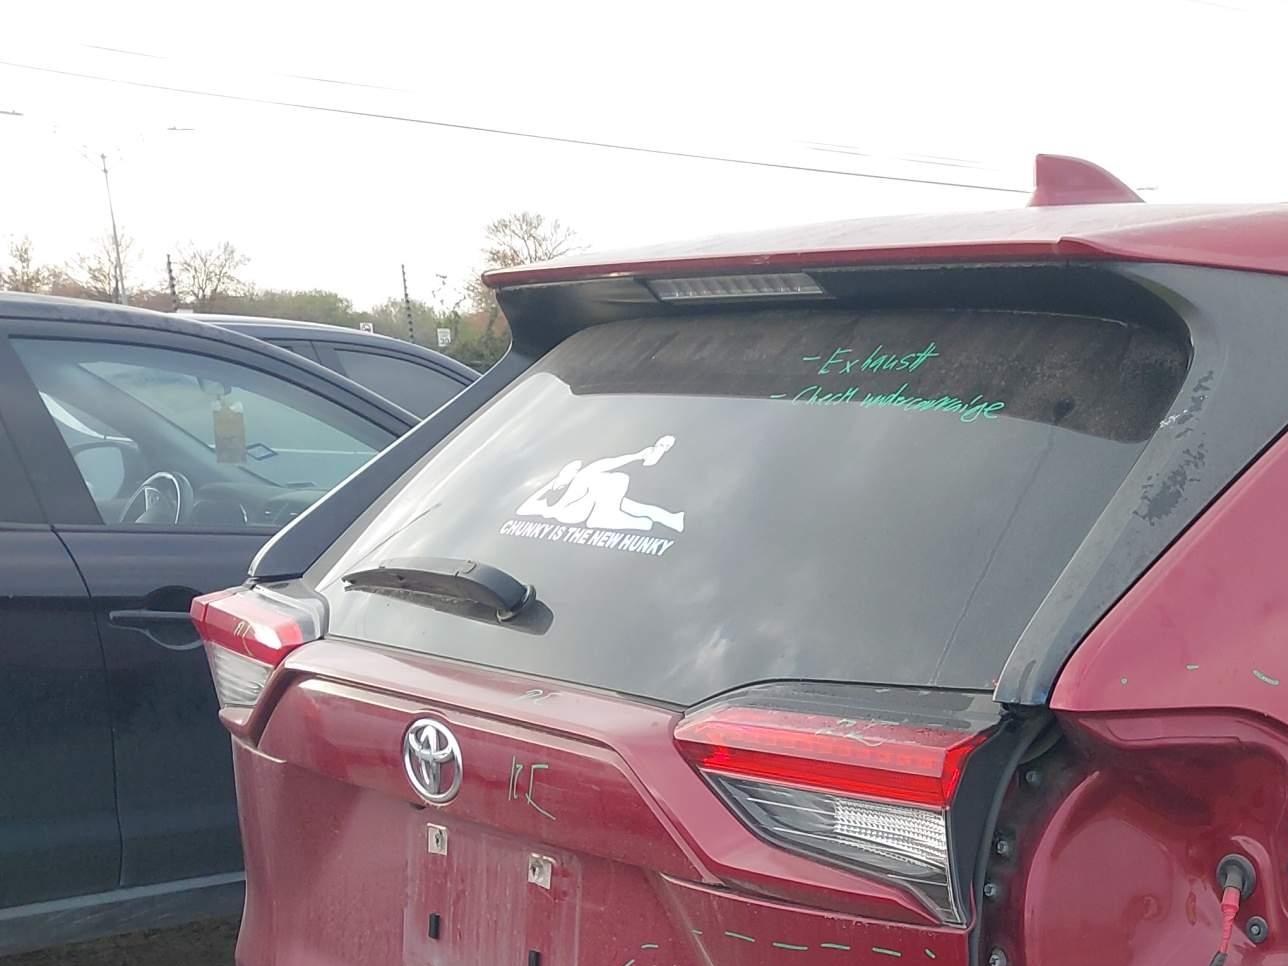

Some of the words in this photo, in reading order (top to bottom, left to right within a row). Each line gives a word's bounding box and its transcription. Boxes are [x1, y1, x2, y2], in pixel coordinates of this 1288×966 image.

[500, 519, 553, 539] CHUNKY
[550, 525, 564, 541] IS
[562, 527, 593, 545] THE
[588, 530, 624, 549] NEW
[618, 534, 675, 556] HUNKY
